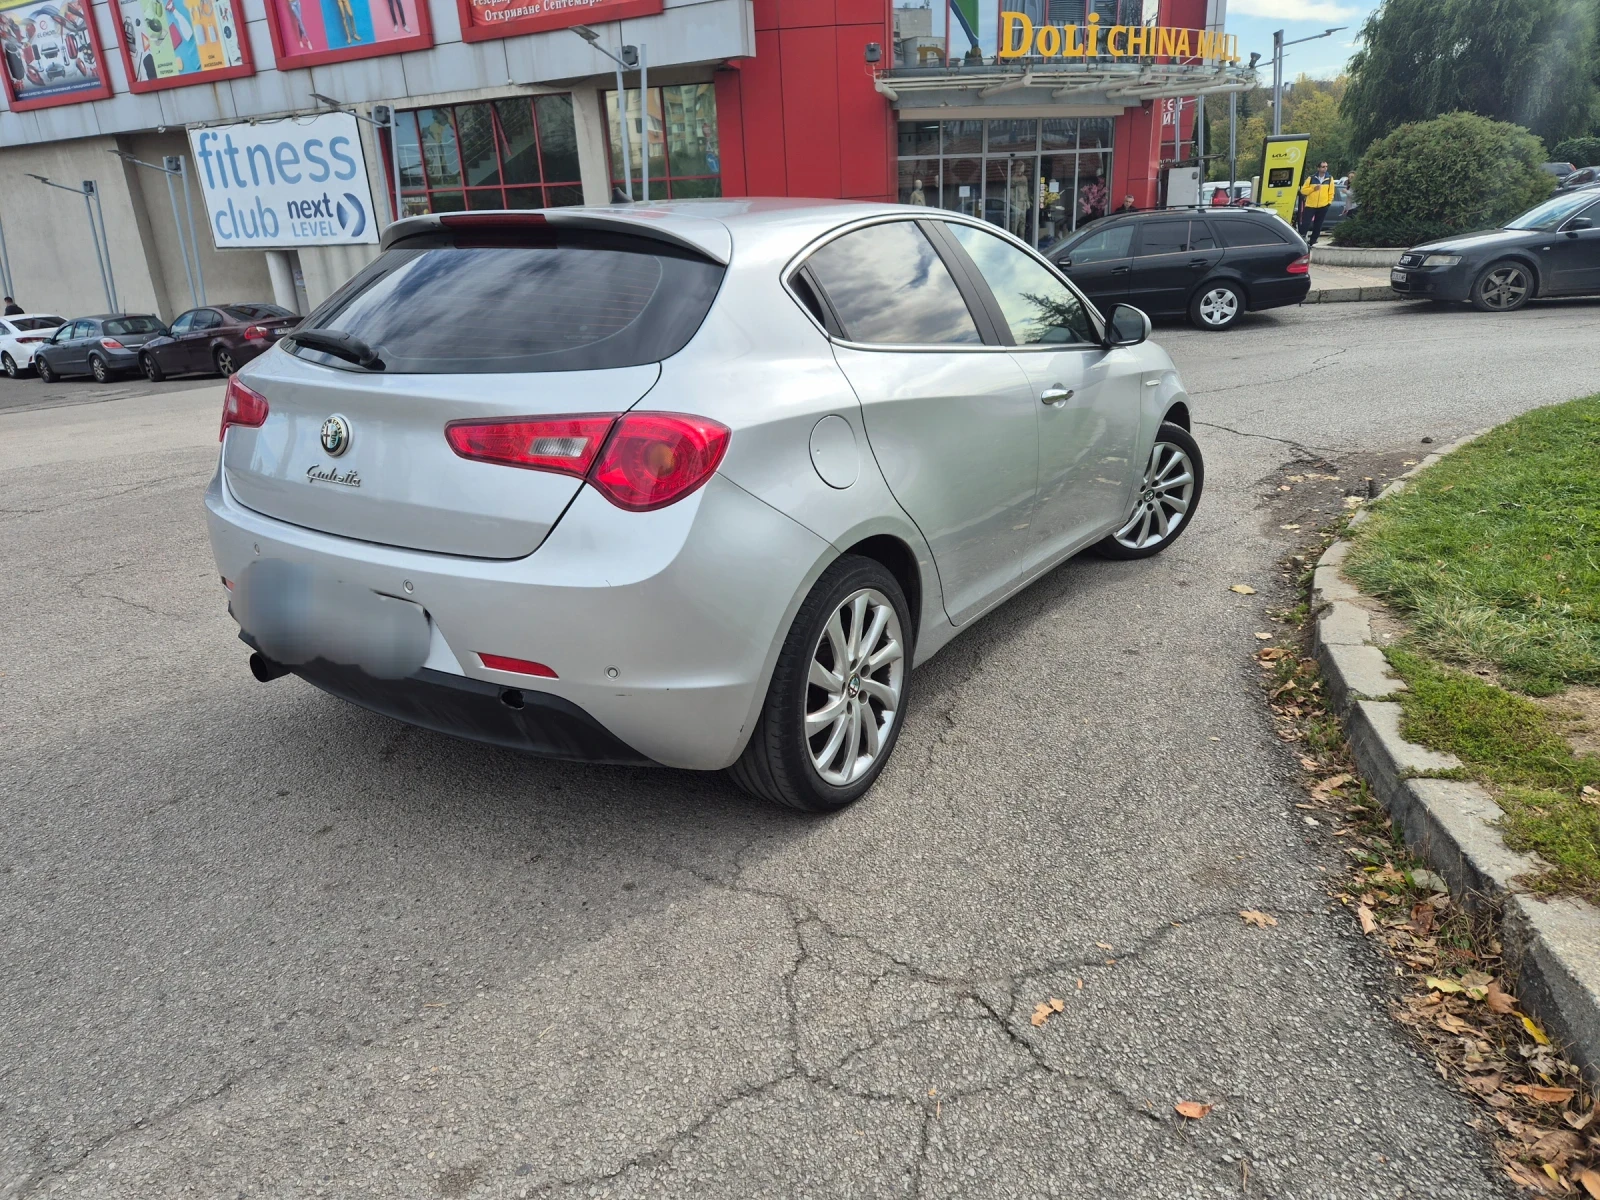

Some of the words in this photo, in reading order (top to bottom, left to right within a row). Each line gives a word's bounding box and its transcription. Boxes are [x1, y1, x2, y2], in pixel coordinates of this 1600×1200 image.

[484, 4, 541, 21] Откриване
[1107, 24, 1192, 58] CHINA
[1196, 29, 1241, 63] MALL
[198, 132, 357, 190] fitness
[215, 195, 280, 240] club
[287, 192, 334, 219] next
[291, 221, 337, 237] LEVEL
[306, 464, 361, 487] Giulietta
